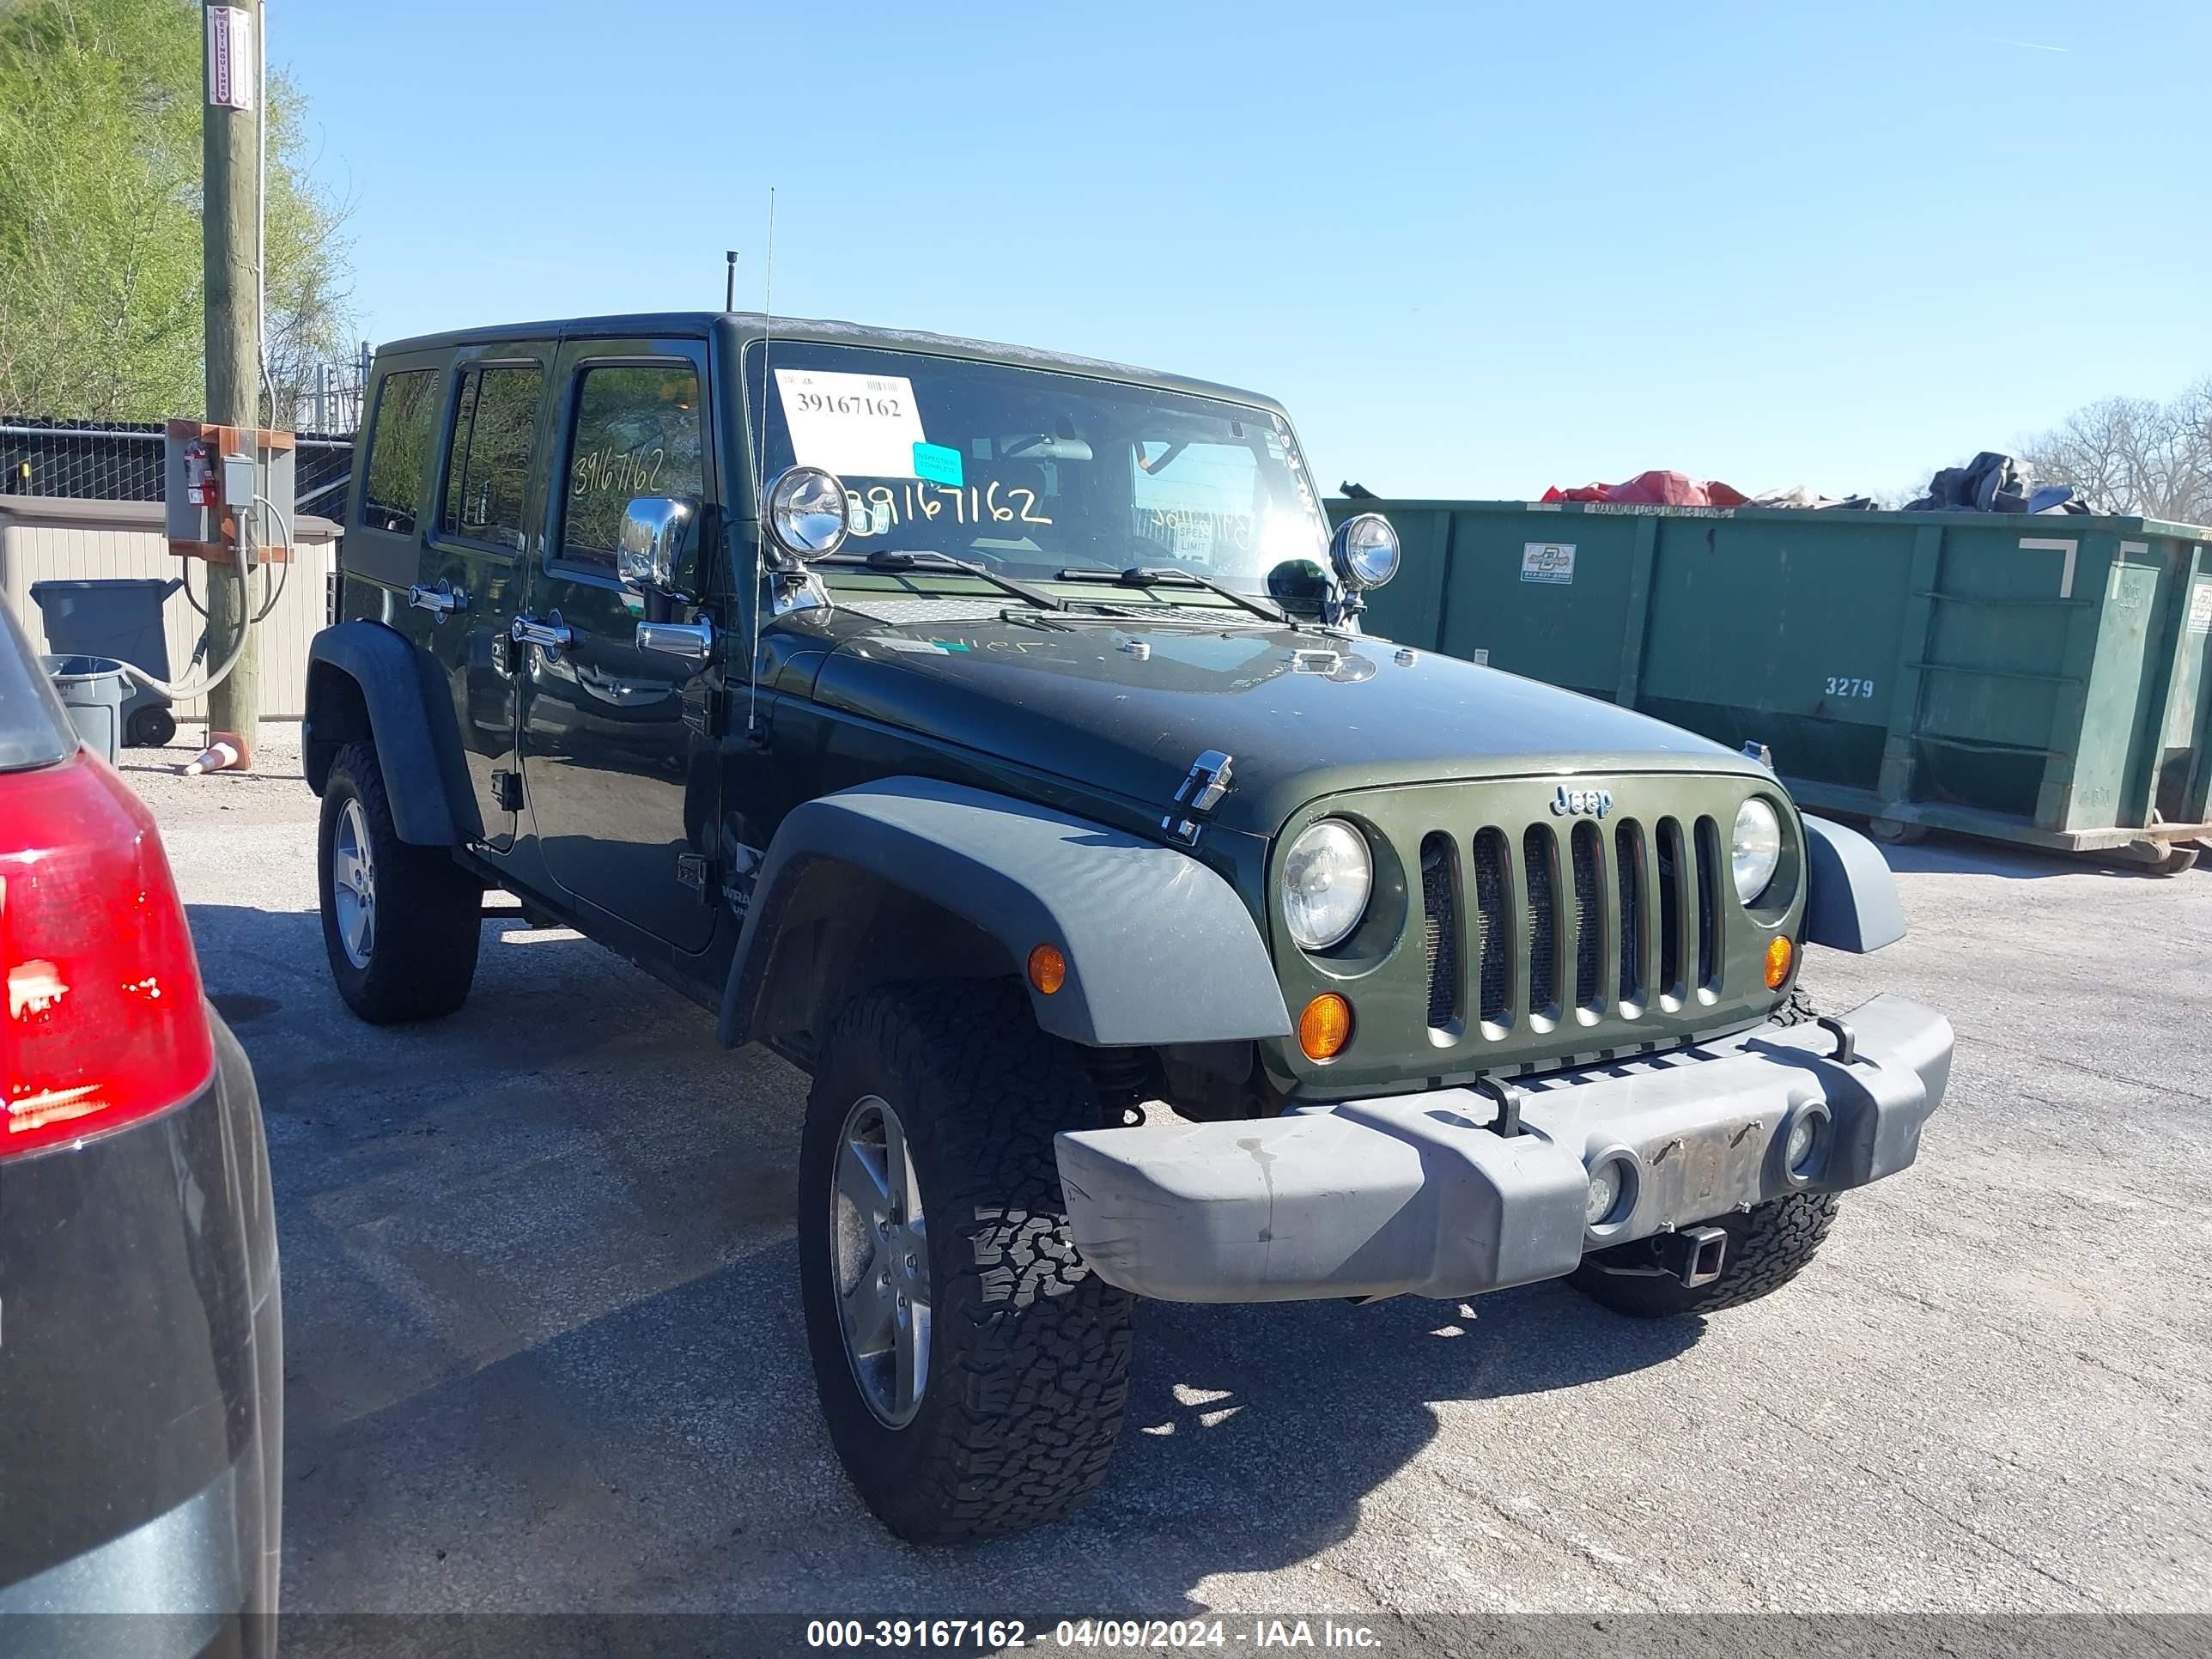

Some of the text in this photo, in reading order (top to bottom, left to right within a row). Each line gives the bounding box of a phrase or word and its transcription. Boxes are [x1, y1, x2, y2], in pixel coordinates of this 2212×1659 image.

[796, 392, 902, 417] 39167162
[574, 445, 664, 495] 39167162
[916, 453, 957, 468] INSPECTION
[920, 461, 956, 474] COMPLETE
[1181, 541, 1206, 552] LIMIT
[1825, 677, 1875, 698] 3279
[1549, 784, 1614, 819] Jeep
